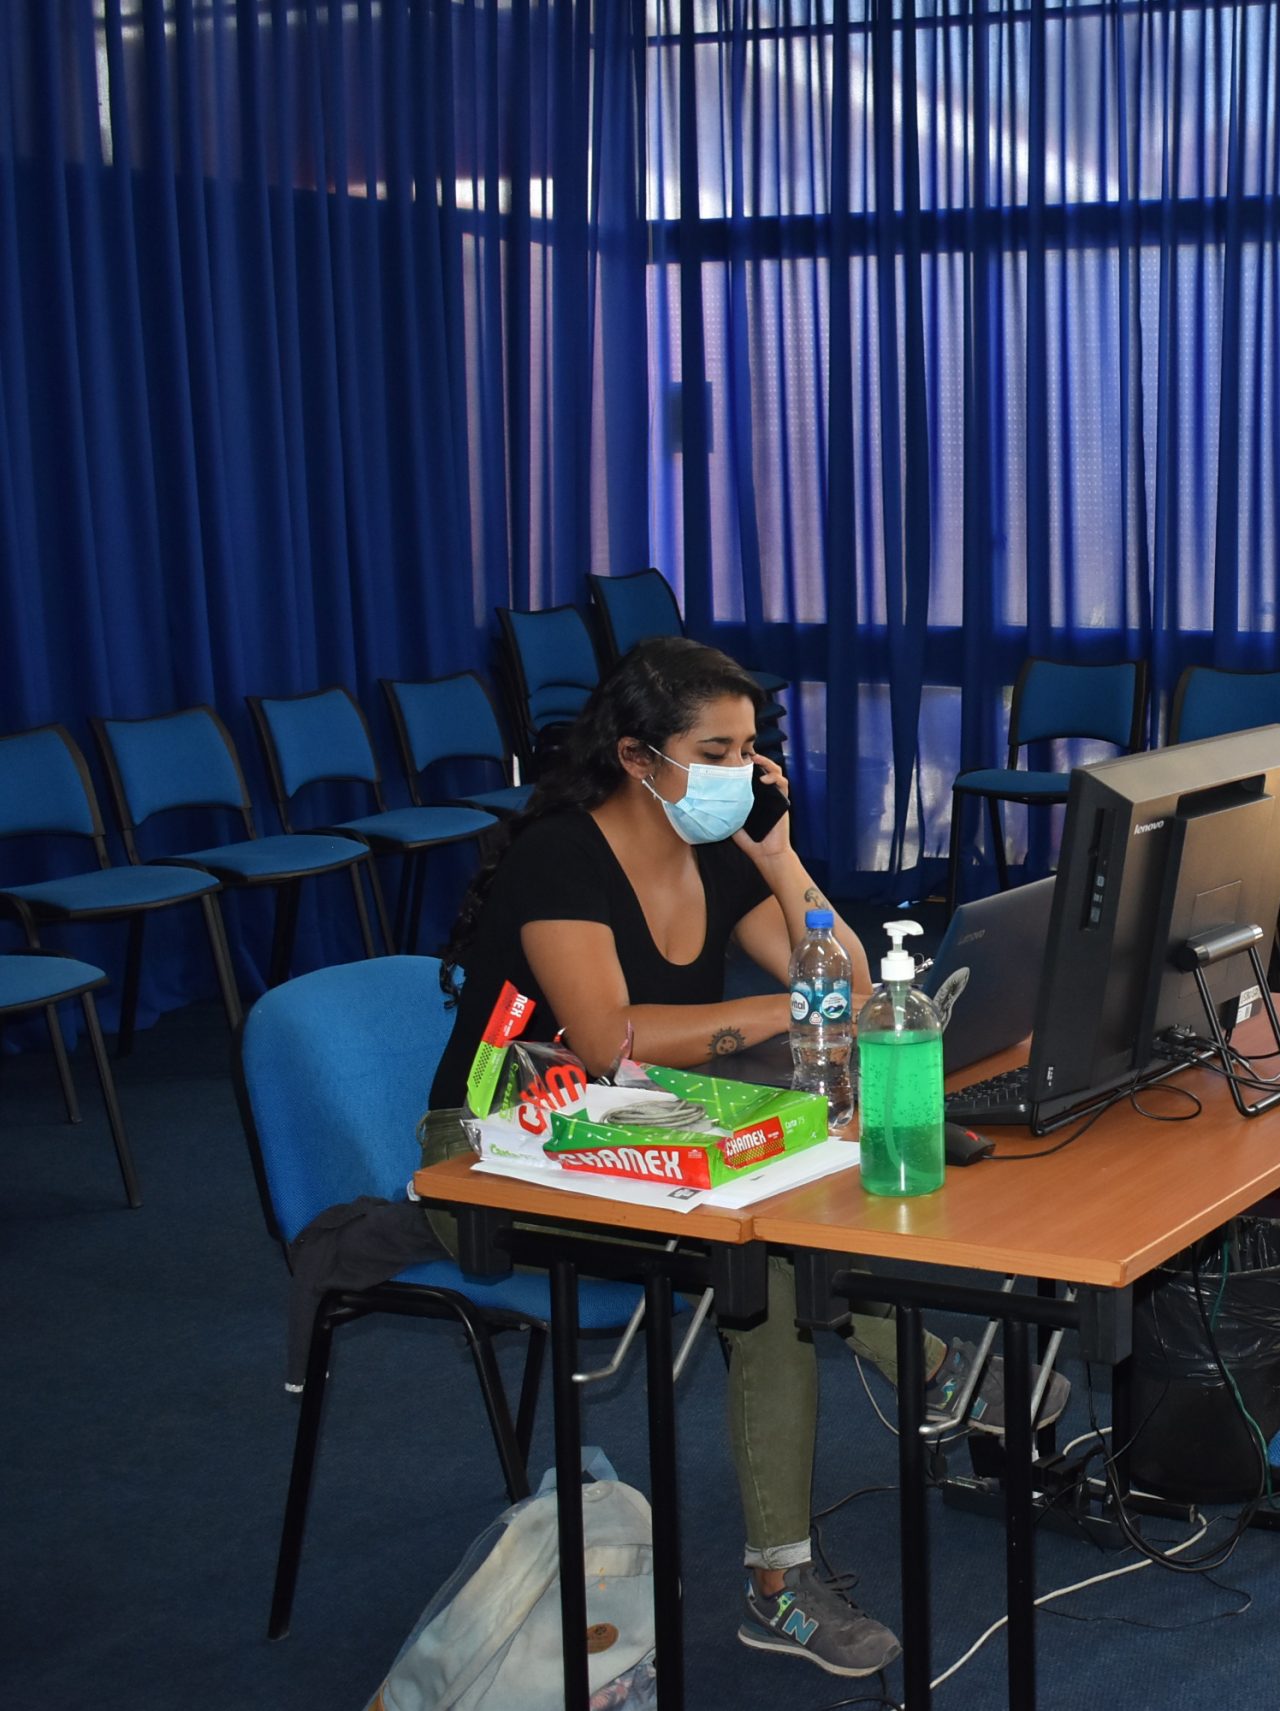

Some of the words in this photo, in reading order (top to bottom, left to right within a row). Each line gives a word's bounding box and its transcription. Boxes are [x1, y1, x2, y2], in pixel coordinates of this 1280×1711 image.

[1134, 820, 1164, 835] lenovo
[725, 1129, 767, 1157] CHAMEX
[558, 1148, 683, 1180] CHAMEX
[782, 1608, 819, 1645] N
